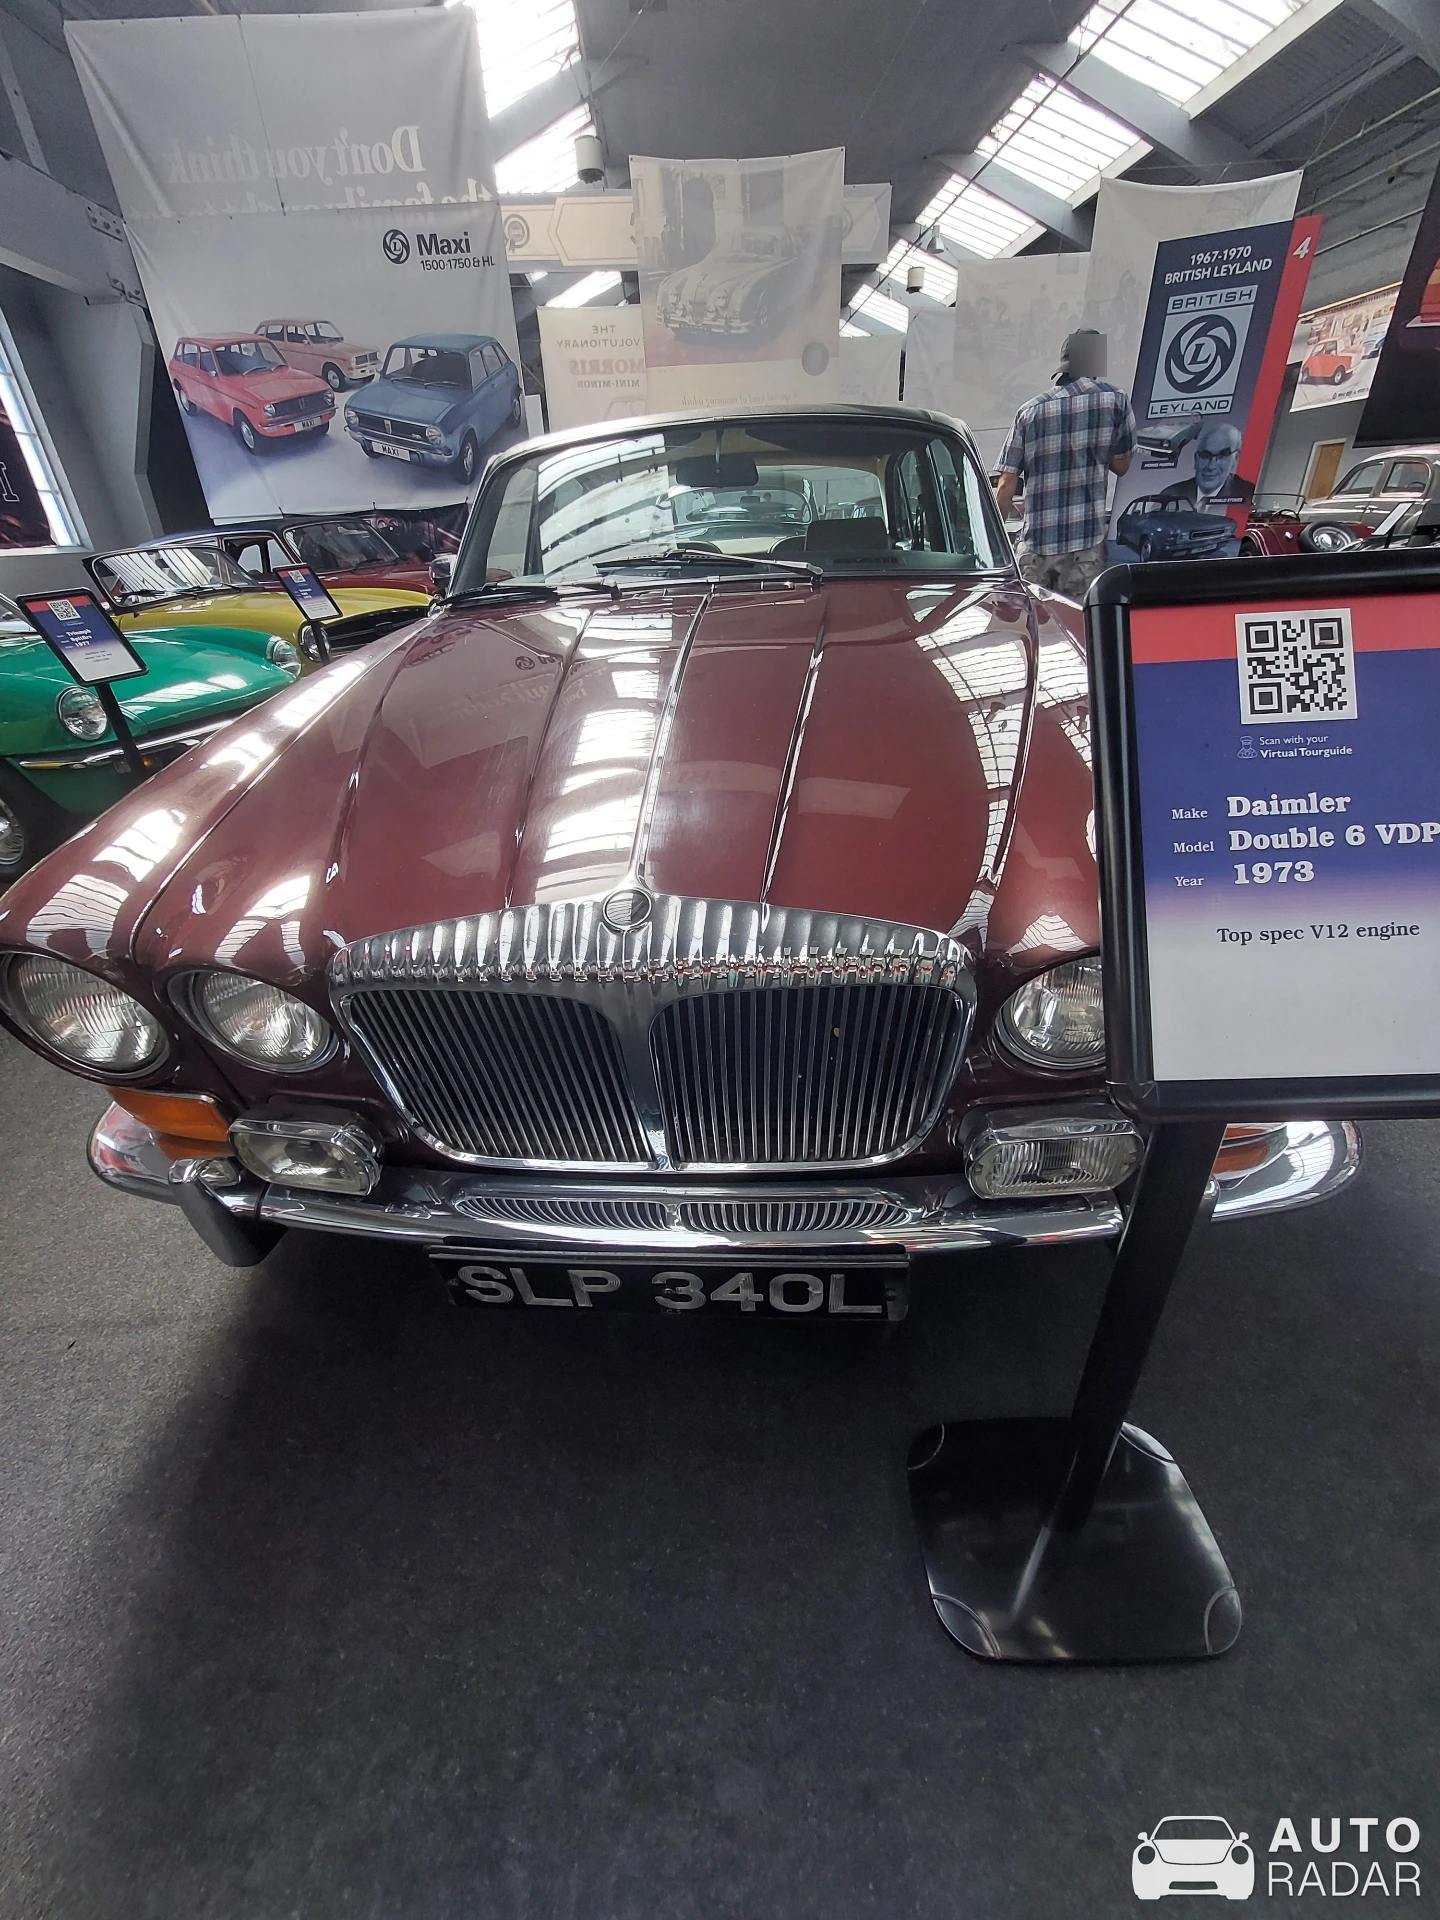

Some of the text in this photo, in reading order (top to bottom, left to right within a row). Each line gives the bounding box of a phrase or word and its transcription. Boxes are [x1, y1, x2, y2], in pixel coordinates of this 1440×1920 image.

[416, 231, 471, 256] Maxi
[1292, 236, 1312, 259] 4
[472, 256, 481, 268] &
[482, 255, 496, 267] HL
[1190, 245, 1252, 266] 1967-1970
[1164, 257, 1273, 286] BRITISH LEYLAND
[1171, 288, 1254, 310] BRITISH
[1150, 399, 1230, 416] LEYLAND
[302, 419, 315, 428] MAXI
[381, 444, 400, 457] MAXI
[65, 628, 92, 637] Triumph
[69, 635, 93, 643] Spitfire
[1259, 735, 1329, 746] Scan with your
[1260, 746, 1353, 759] Virtual Tourguide
[1172, 792, 1351, 820] Make Daimler
[1173, 822, 1440, 854] Model Double 6 VDP
[1175, 860, 1315, 887] Year 1973
[1216, 921, 1420, 946] Top spec V12 engine
[457, 1265, 883, 1313] SLP 340L
